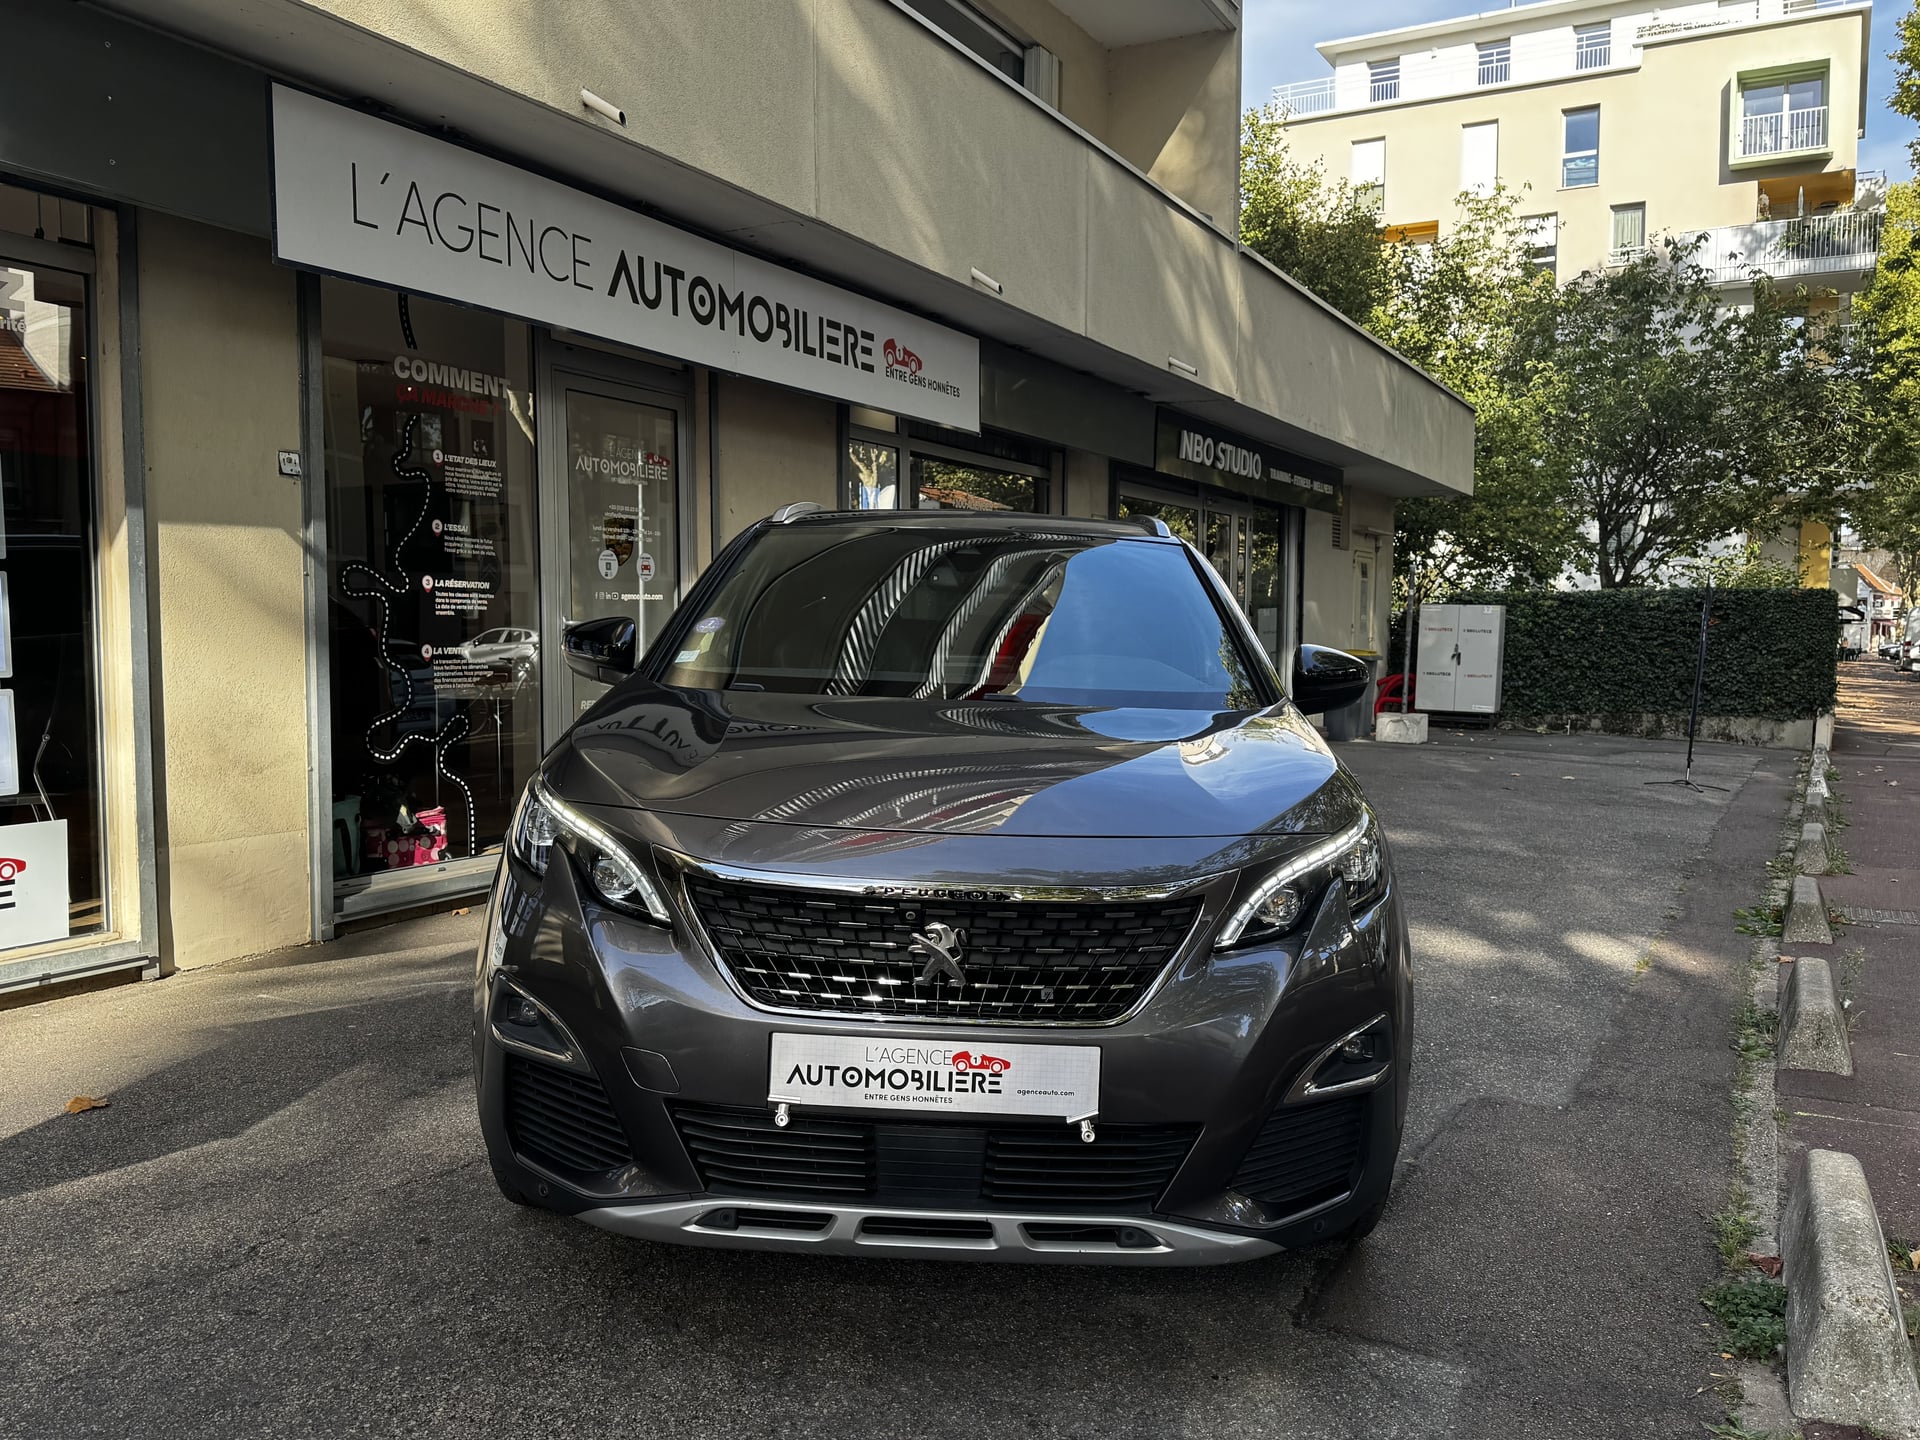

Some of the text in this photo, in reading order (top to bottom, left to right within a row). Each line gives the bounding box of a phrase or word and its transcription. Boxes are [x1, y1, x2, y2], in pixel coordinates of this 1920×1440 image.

[351, 162, 875, 374] L'AGENCE AUTOMOBILIERE
[394, 356, 511, 399] COMMENT
[885, 366, 961, 398] ENTRE GENS HONNÊTES
[421, 390, 489, 415] MARCHE
[465, 457, 478, 466] DES
[479, 459, 497, 468] LIEUX
[1179, 430, 1262, 480] NBO STUDIO
[576, 455, 668, 481] AUTOMOBILIERE
[444, 524, 468, 532] L'ESSAI
[435, 578, 490, 590] LA RÉSERVATION
[433, 647, 443, 655] LA
[884, 887, 1002, 900] PEUGEOT
[865, 1046, 953, 1067] L'AGENCE
[787, 1064, 1003, 1095] AUTOMOBILIERE
[865, 1093, 953, 1105] ENTRE GENS HONNÊTES
[1016, 1088, 1076, 1098] agenceauto.com
